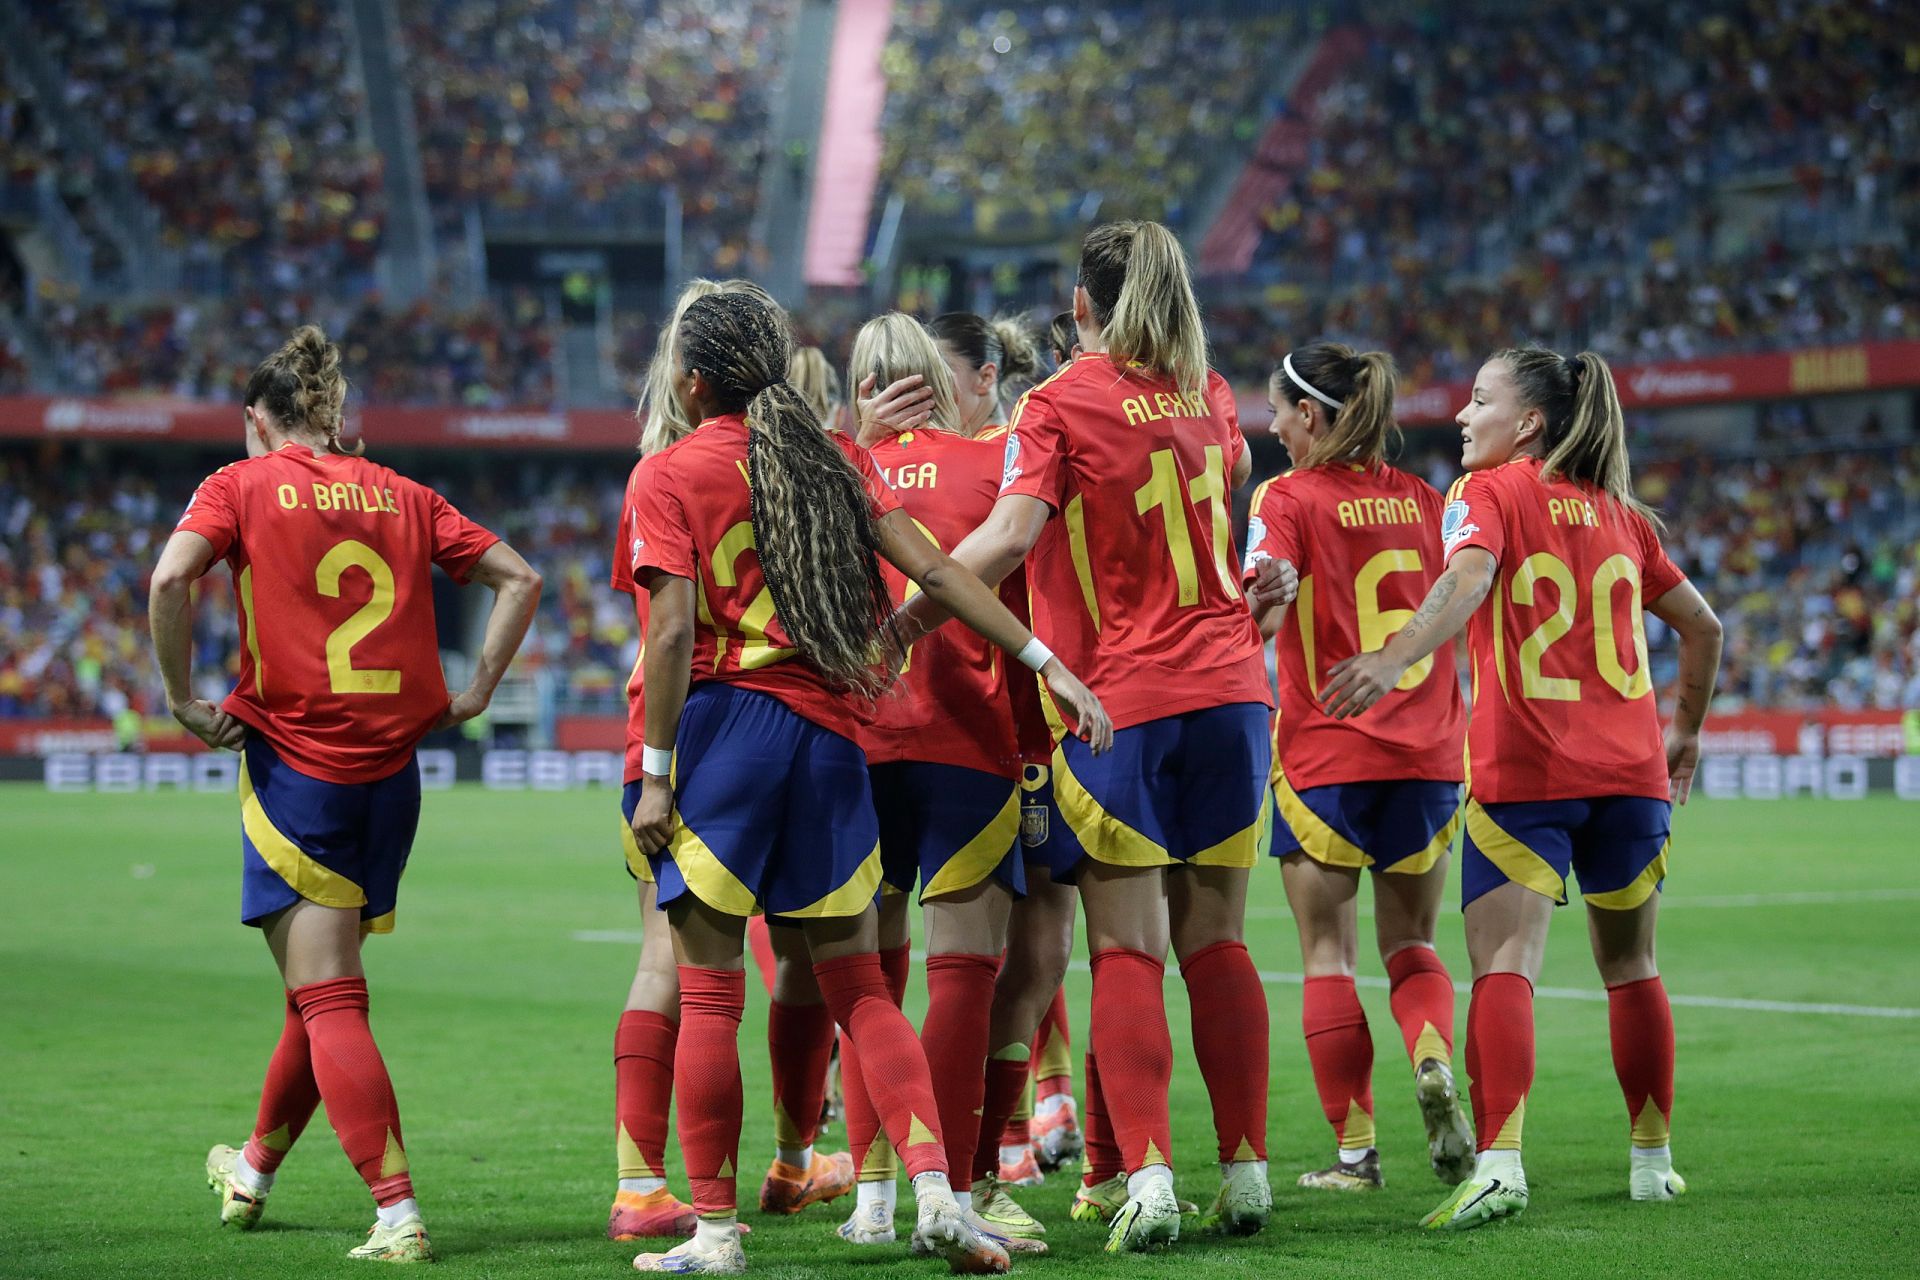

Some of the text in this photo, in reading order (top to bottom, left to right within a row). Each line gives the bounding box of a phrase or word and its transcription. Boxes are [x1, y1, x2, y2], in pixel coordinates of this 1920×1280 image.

[1121, 391, 1211, 426] ALEXIA
[883, 462, 938, 491] LGA
[277, 482, 400, 515] O. BATLLE
[1337, 497, 1422, 527] AITANA
[1548, 498, 1600, 527] PINA
[1134, 445, 1241, 608] 11
[315, 539, 401, 694] 2
[1354, 549, 1434, 691] 6
[1511, 552, 1652, 701] 20
